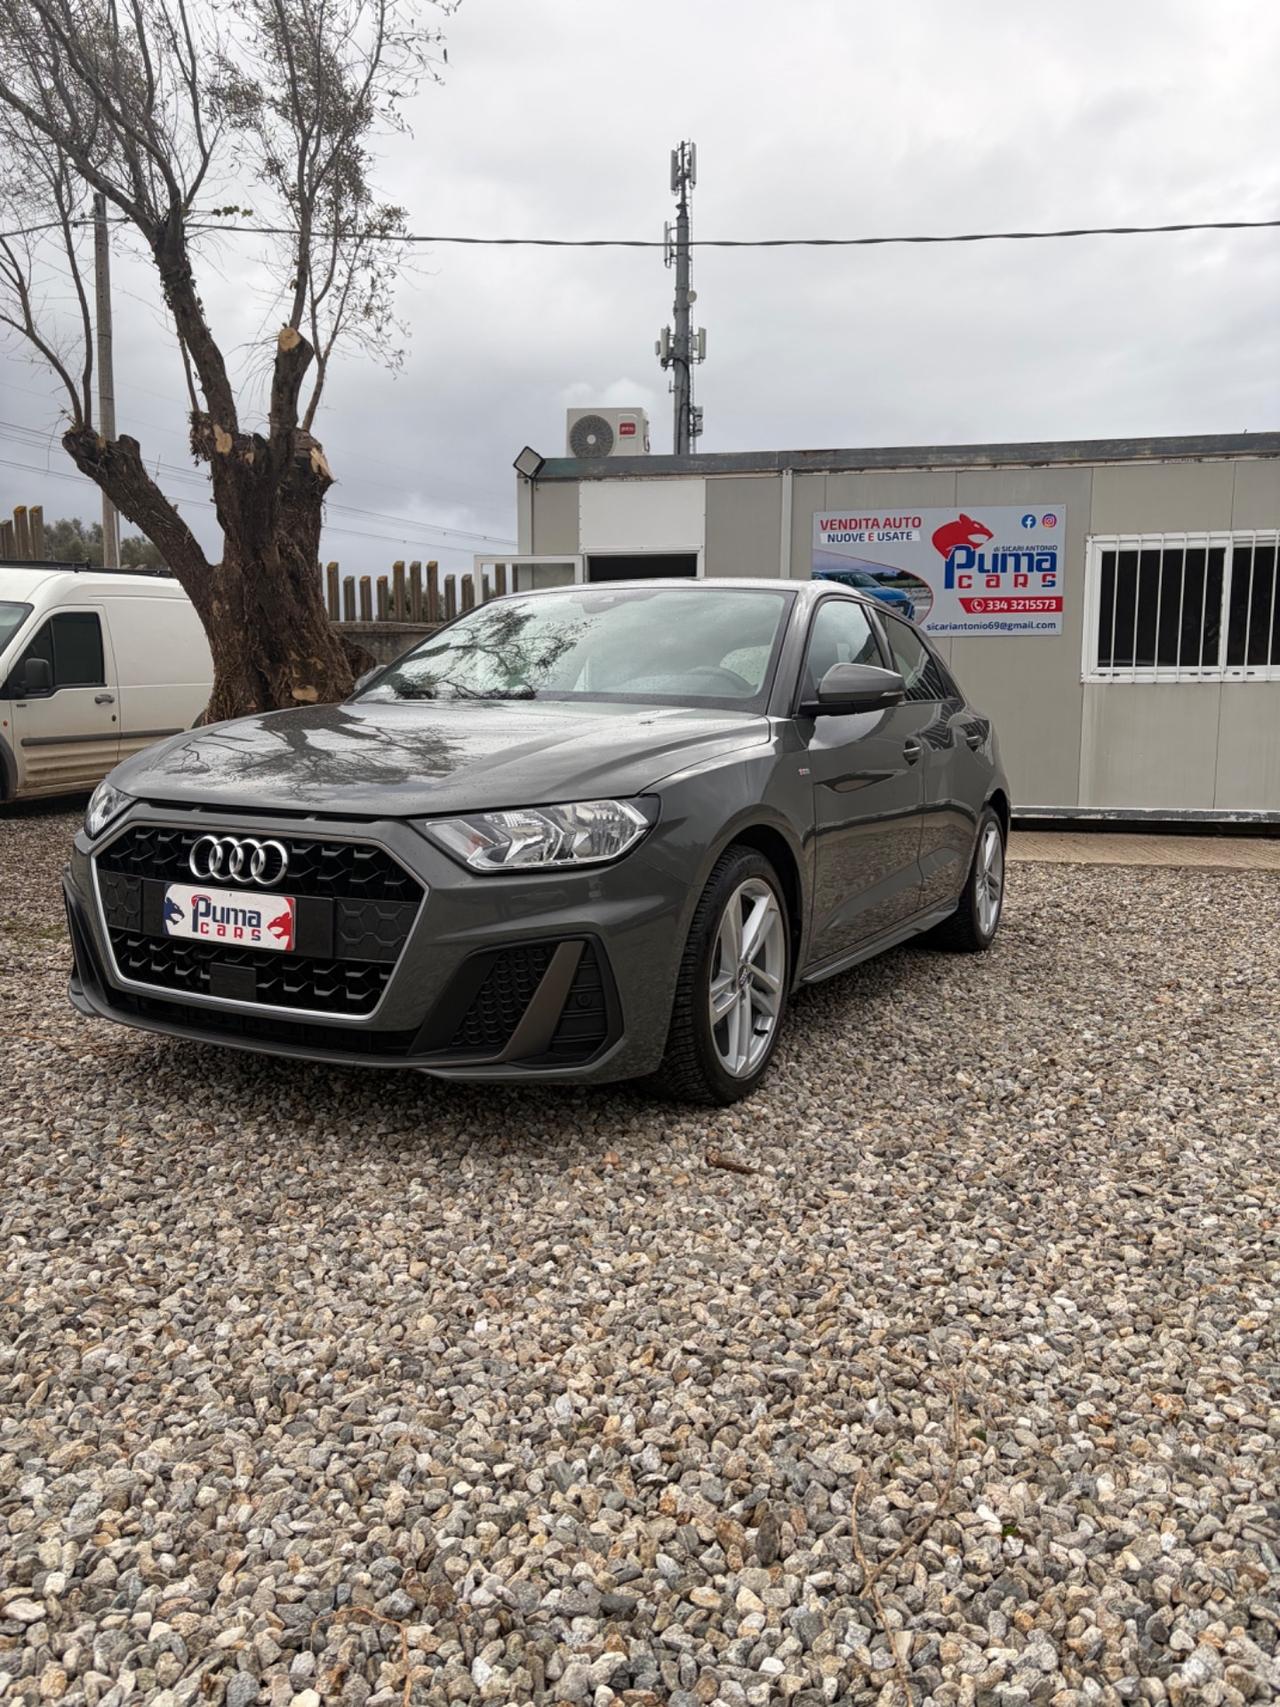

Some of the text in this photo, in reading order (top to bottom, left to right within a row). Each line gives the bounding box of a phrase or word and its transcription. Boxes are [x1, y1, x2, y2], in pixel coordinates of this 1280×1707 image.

[820, 516, 922, 531] VENDITA AUTO
[827, 531, 912, 543] NUOVE E USATE
[944, 545, 1057, 589] Puma
[986, 599, 1056, 610] 334 3215573
[926, 621, 1056, 631] sicariantonio69@gmail.com
[192, 896, 261, 933] Puma
